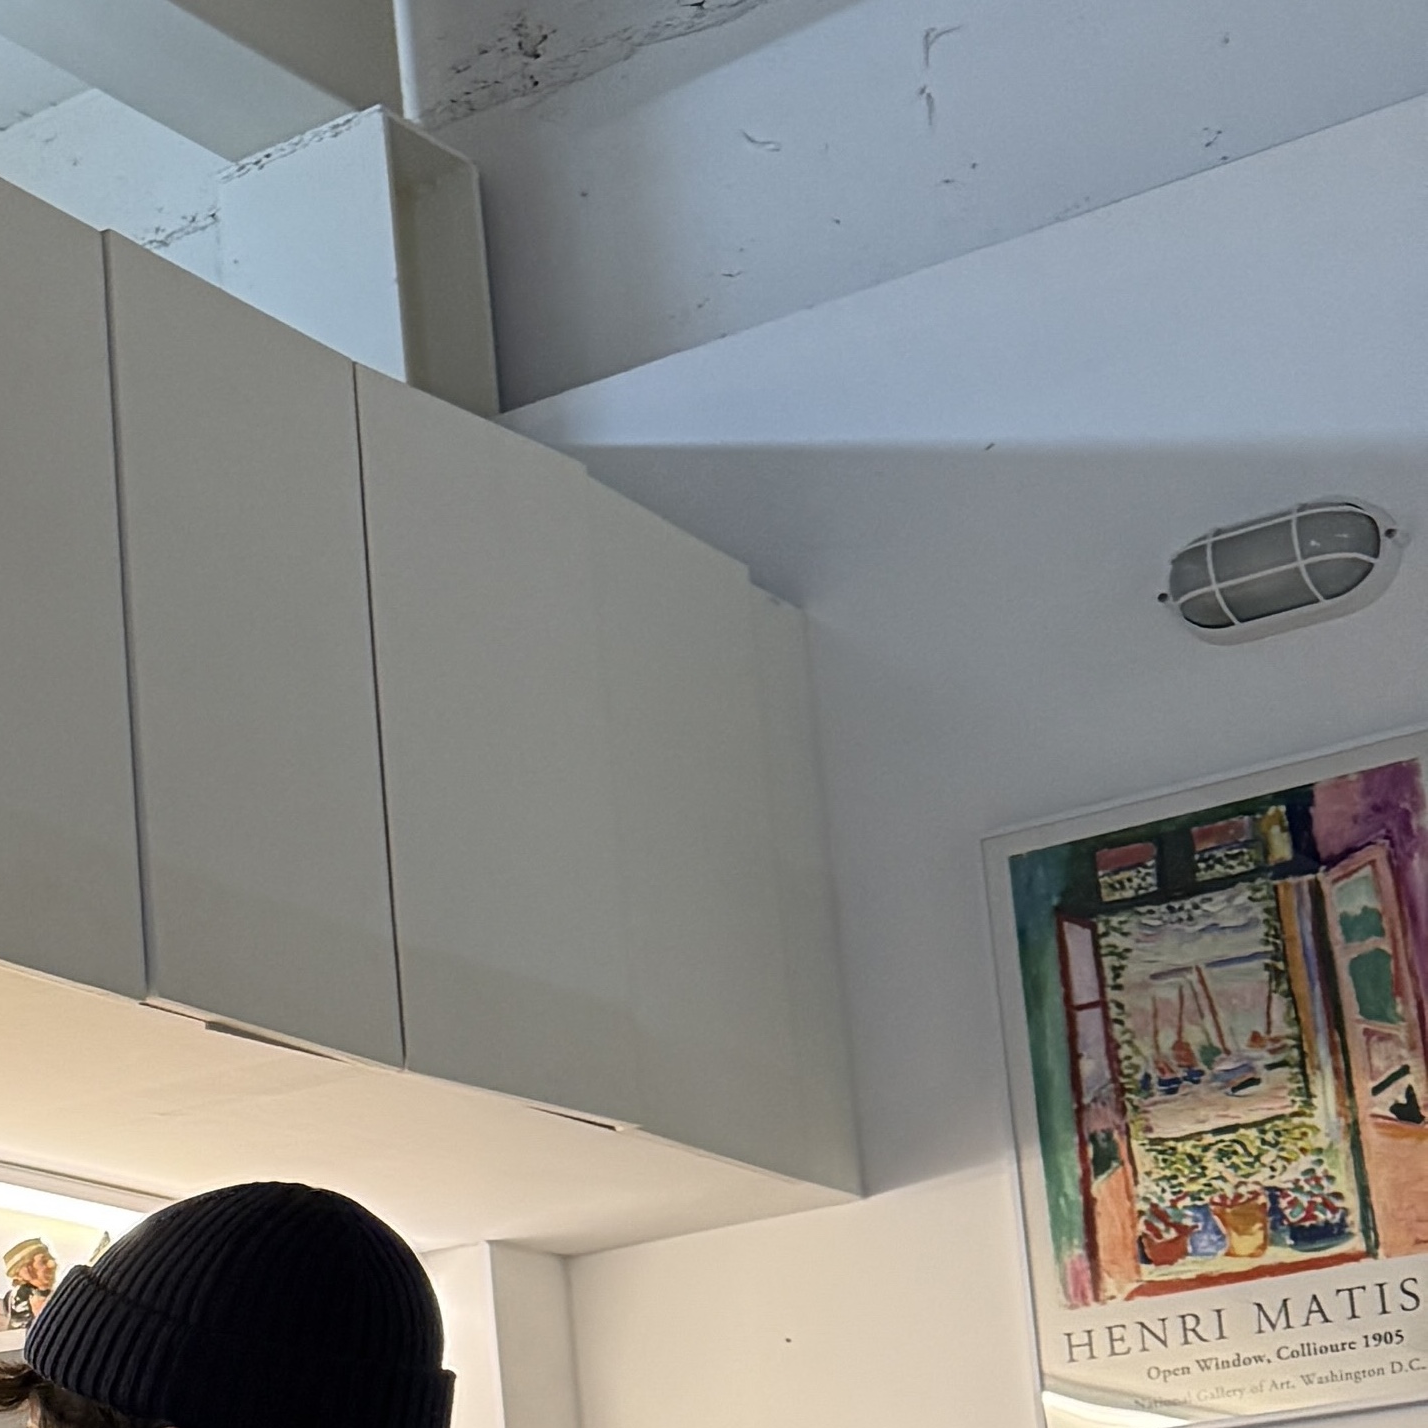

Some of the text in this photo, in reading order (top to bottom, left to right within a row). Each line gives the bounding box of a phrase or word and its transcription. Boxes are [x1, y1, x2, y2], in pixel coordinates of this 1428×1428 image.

[1064, 1277, 1421, 1364] HENRI MATIS
[1147, 1329, 1405, 1383] Open Window, Collioure 1905
[1196, 1384, 1246, 1401] Gallery
[1250, 1379, 1265, 1394] of
[1300, 1366, 1386, 1386] Washington
[1390, 1358, 1428, 1375] D.C.
